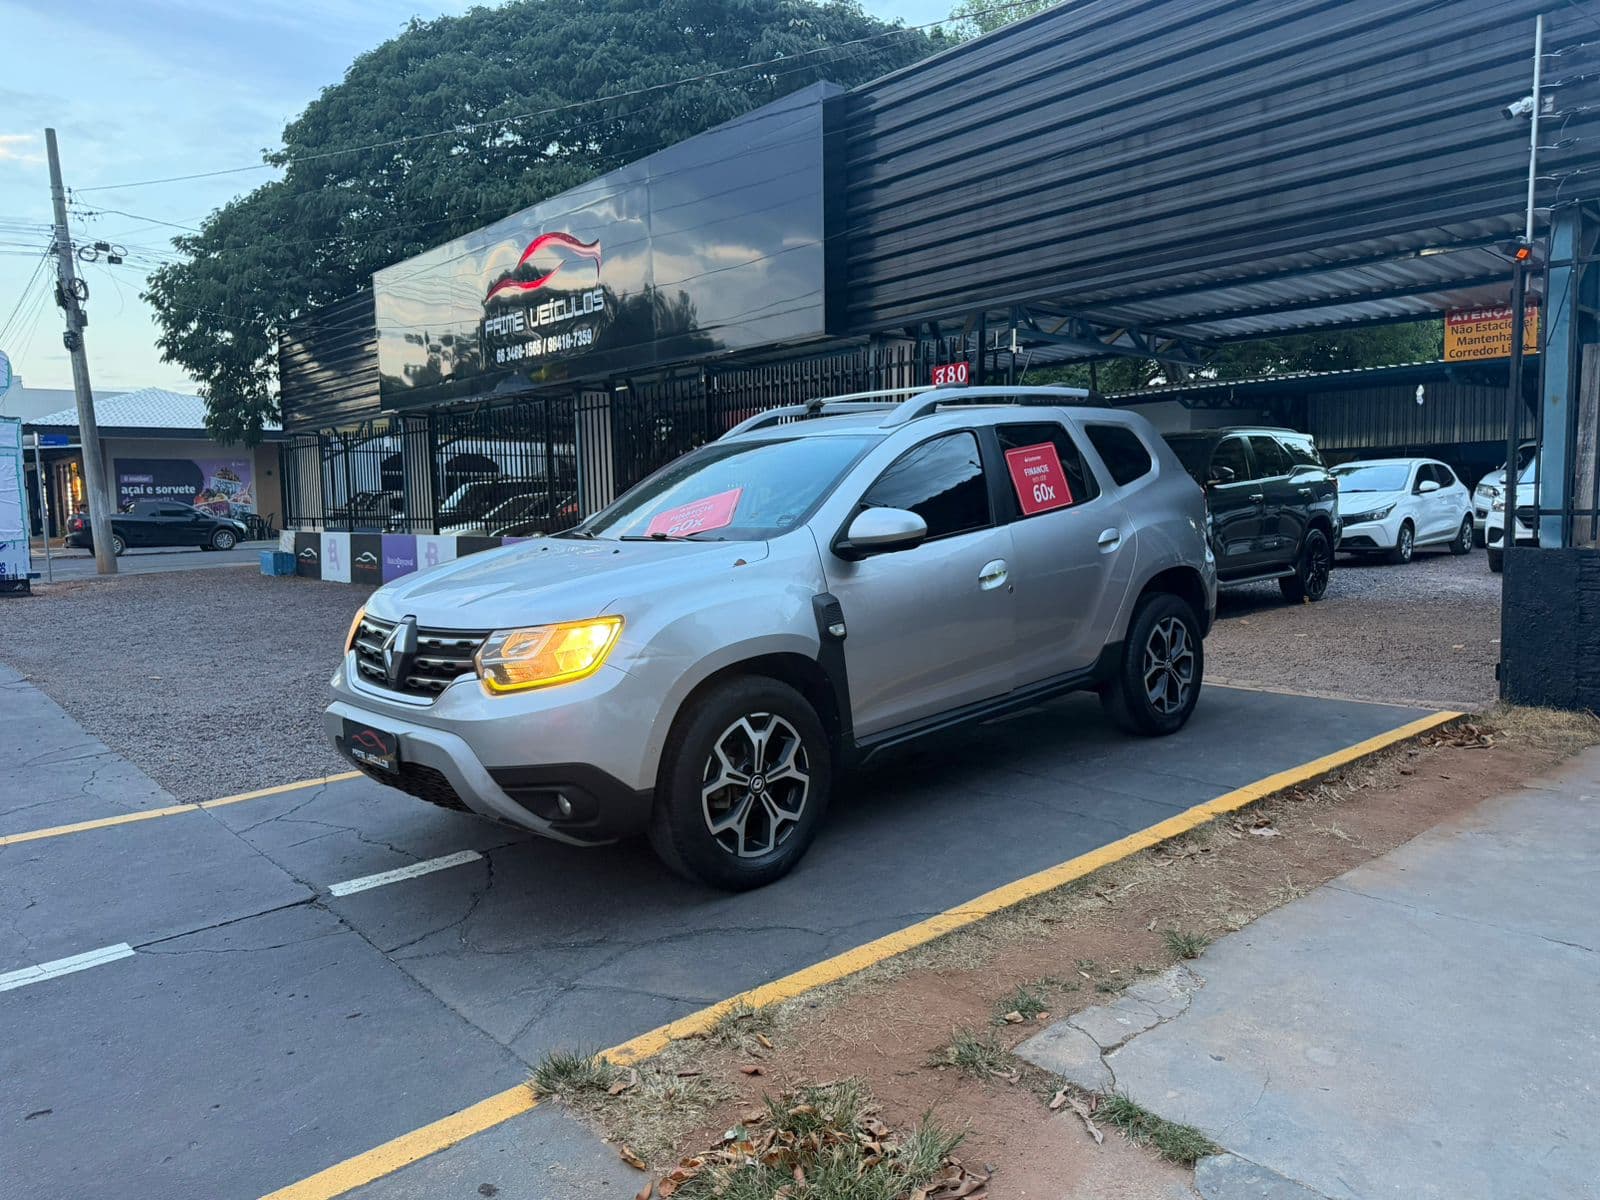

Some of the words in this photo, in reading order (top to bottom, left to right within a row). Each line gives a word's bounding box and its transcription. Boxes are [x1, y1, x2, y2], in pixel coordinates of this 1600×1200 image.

[529, 288, 604, 328] VEÍCULOS
[1451, 324, 1473, 336] Não
[1456, 331, 1513, 347] Mantenha
[1449, 346, 1499, 359] Corredor
[935, 364, 966, 385] 380
[1024, 464, 1049, 477] FINANCIE
[121, 484, 144, 497] açaí
[146, 486, 153, 495] e
[155, 485, 196, 495] sorvete
[1033, 483, 1056, 503] 60x
